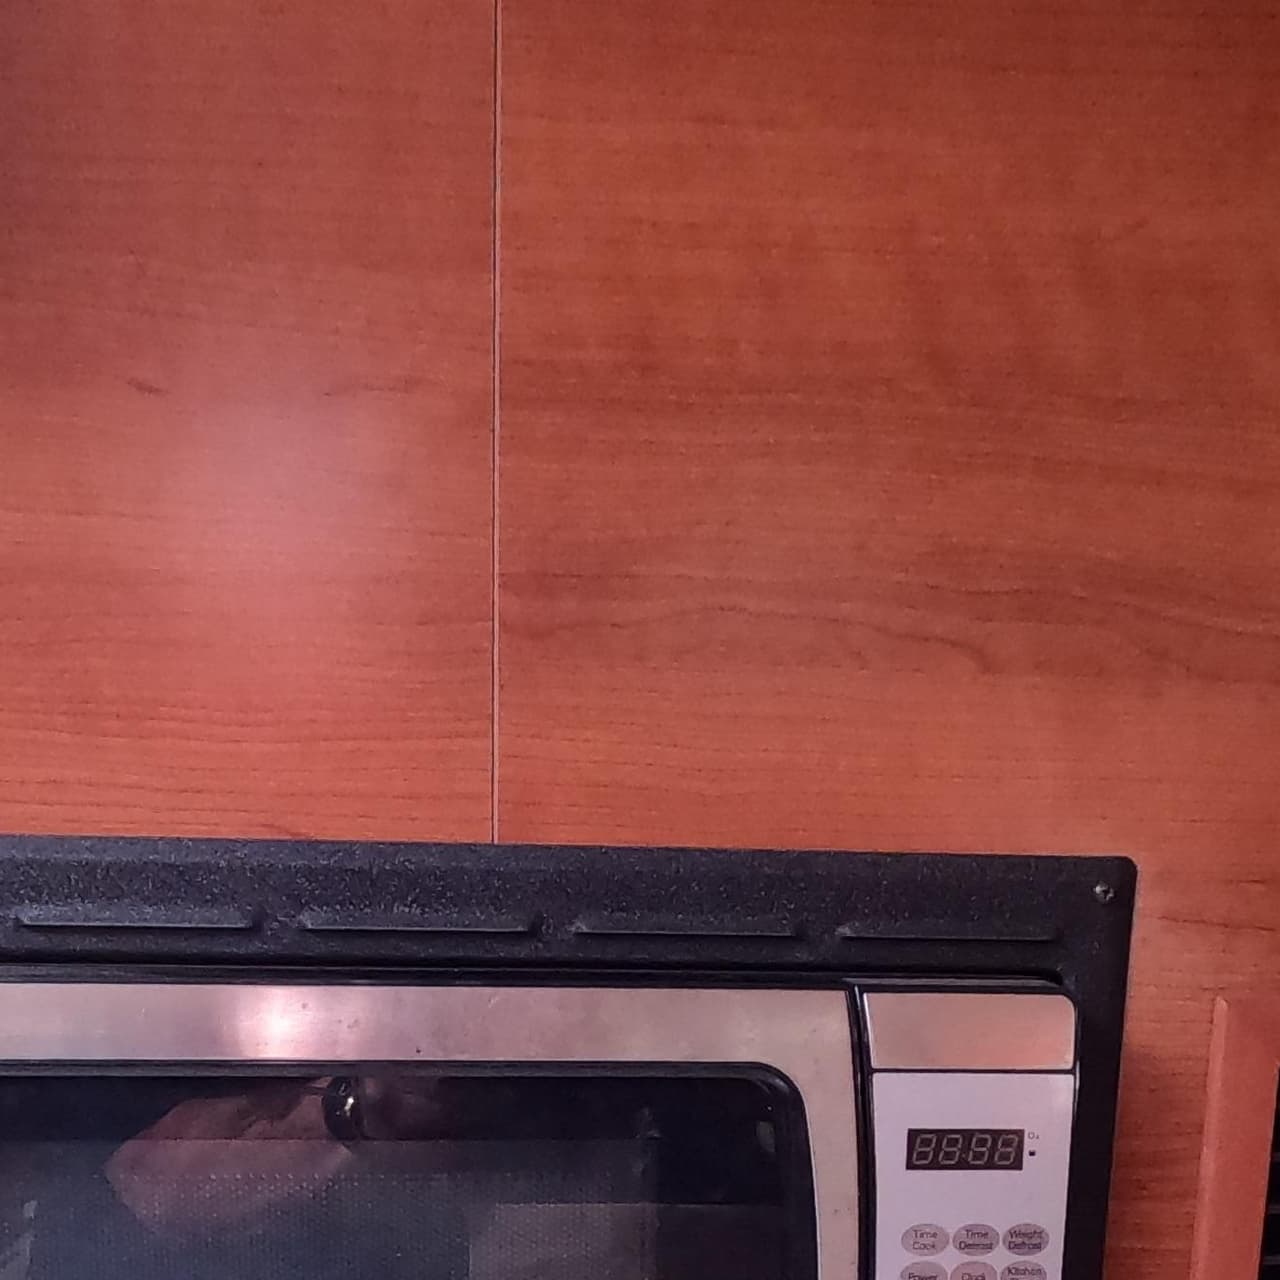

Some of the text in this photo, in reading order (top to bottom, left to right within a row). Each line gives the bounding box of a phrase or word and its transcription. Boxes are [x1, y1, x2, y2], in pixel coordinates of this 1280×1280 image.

[913, 1229, 938, 1239] Time
[965, 1229, 989, 1239] Time
[1008, 1241, 1042, 1250] Defrost
[1007, 1266, 1042, 1276] Kitchen
